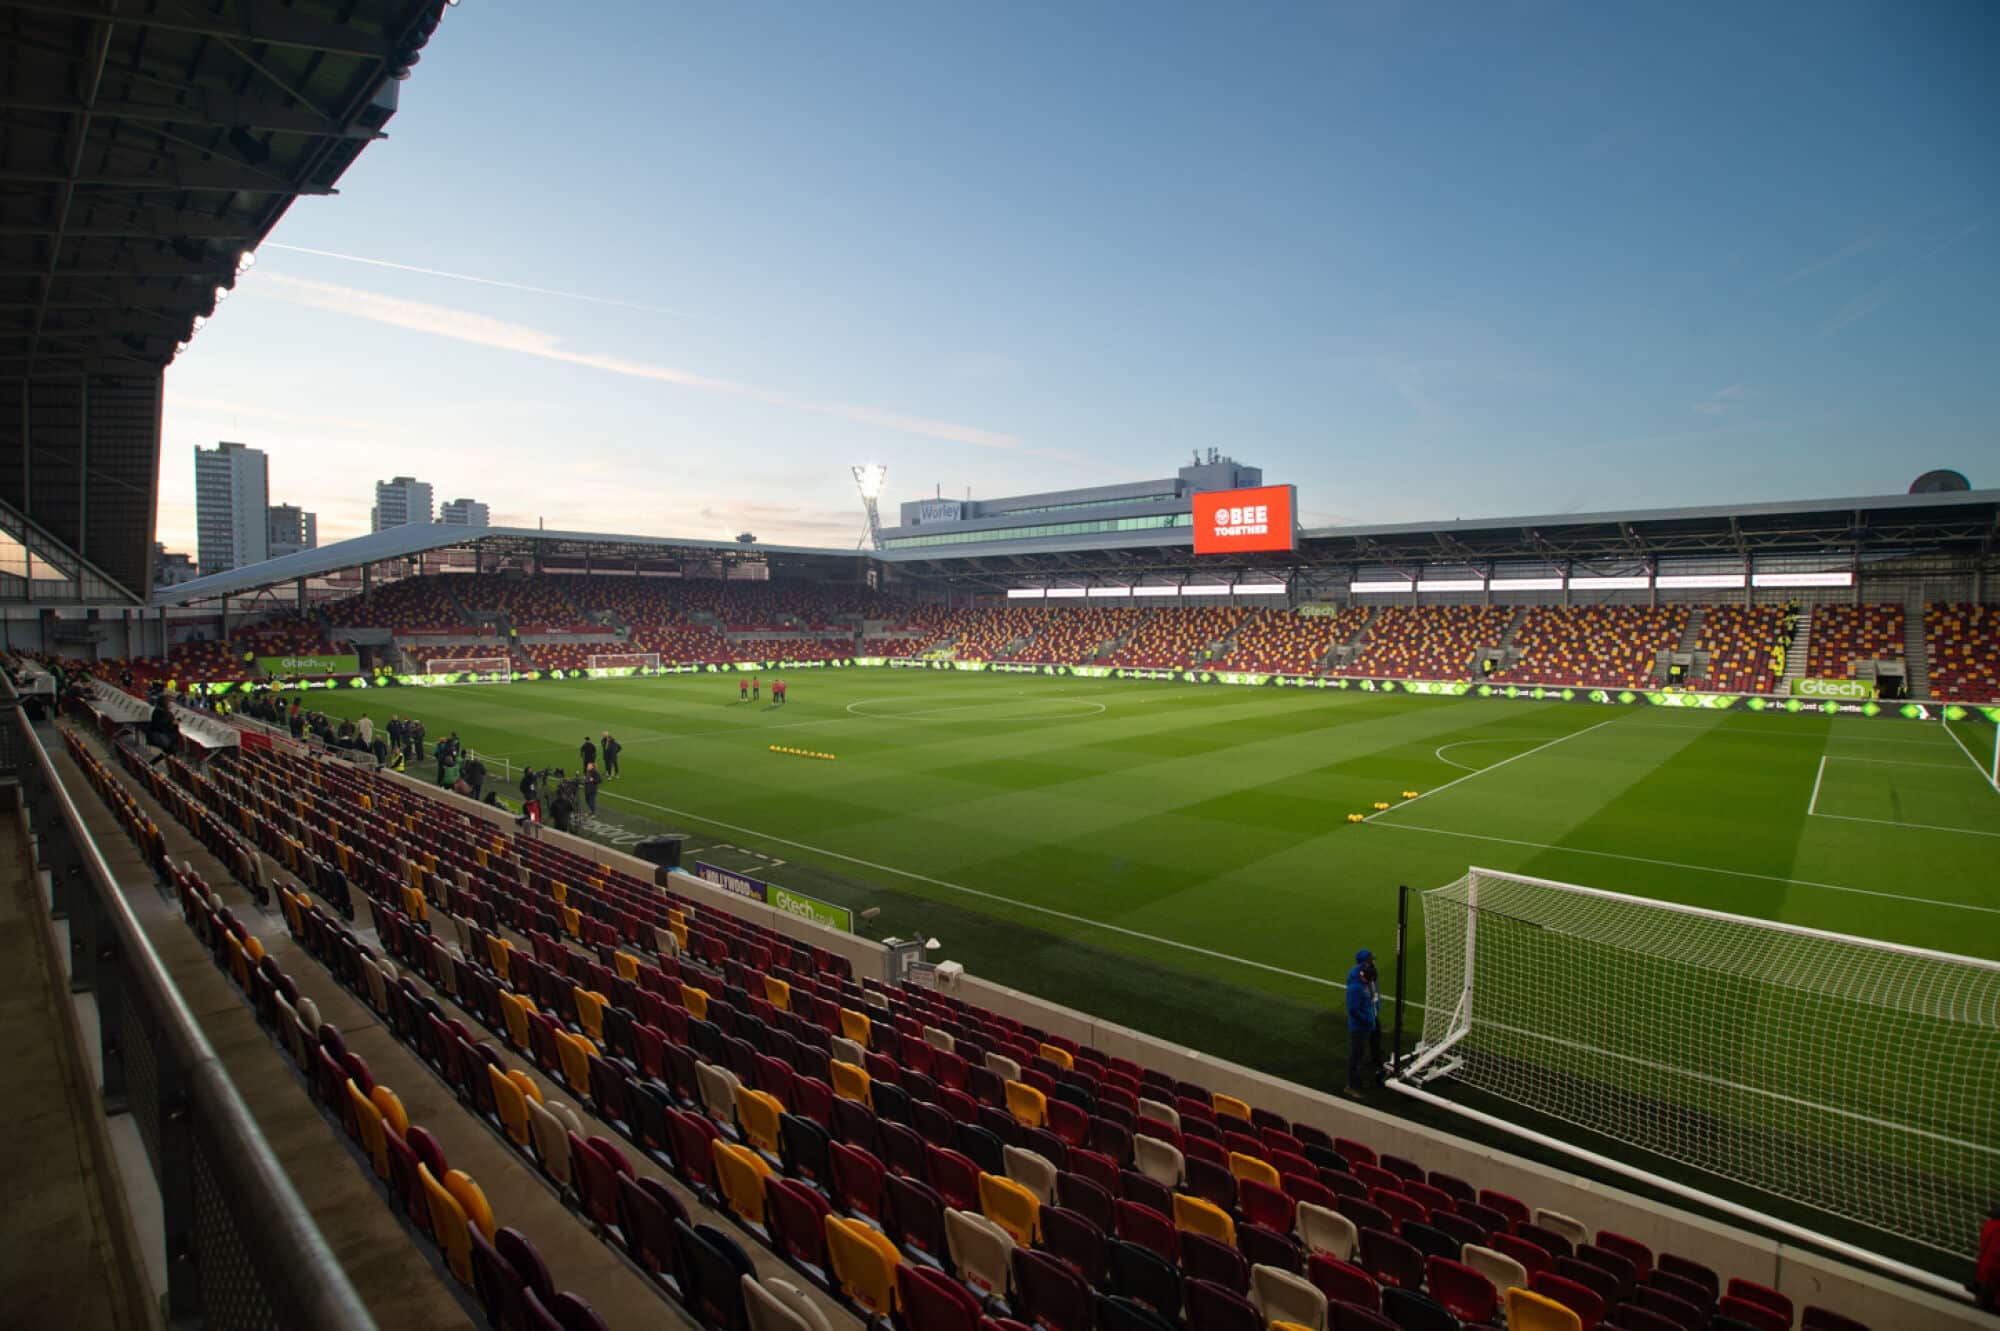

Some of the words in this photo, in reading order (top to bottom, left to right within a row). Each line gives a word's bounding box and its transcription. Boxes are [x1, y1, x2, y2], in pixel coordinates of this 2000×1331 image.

[921, 504, 959, 520] Worley
[1230, 506, 1267, 525] BEE
[1214, 524, 1268, 536] TOGETHER
[1800, 679, 1865, 696] Gtech
